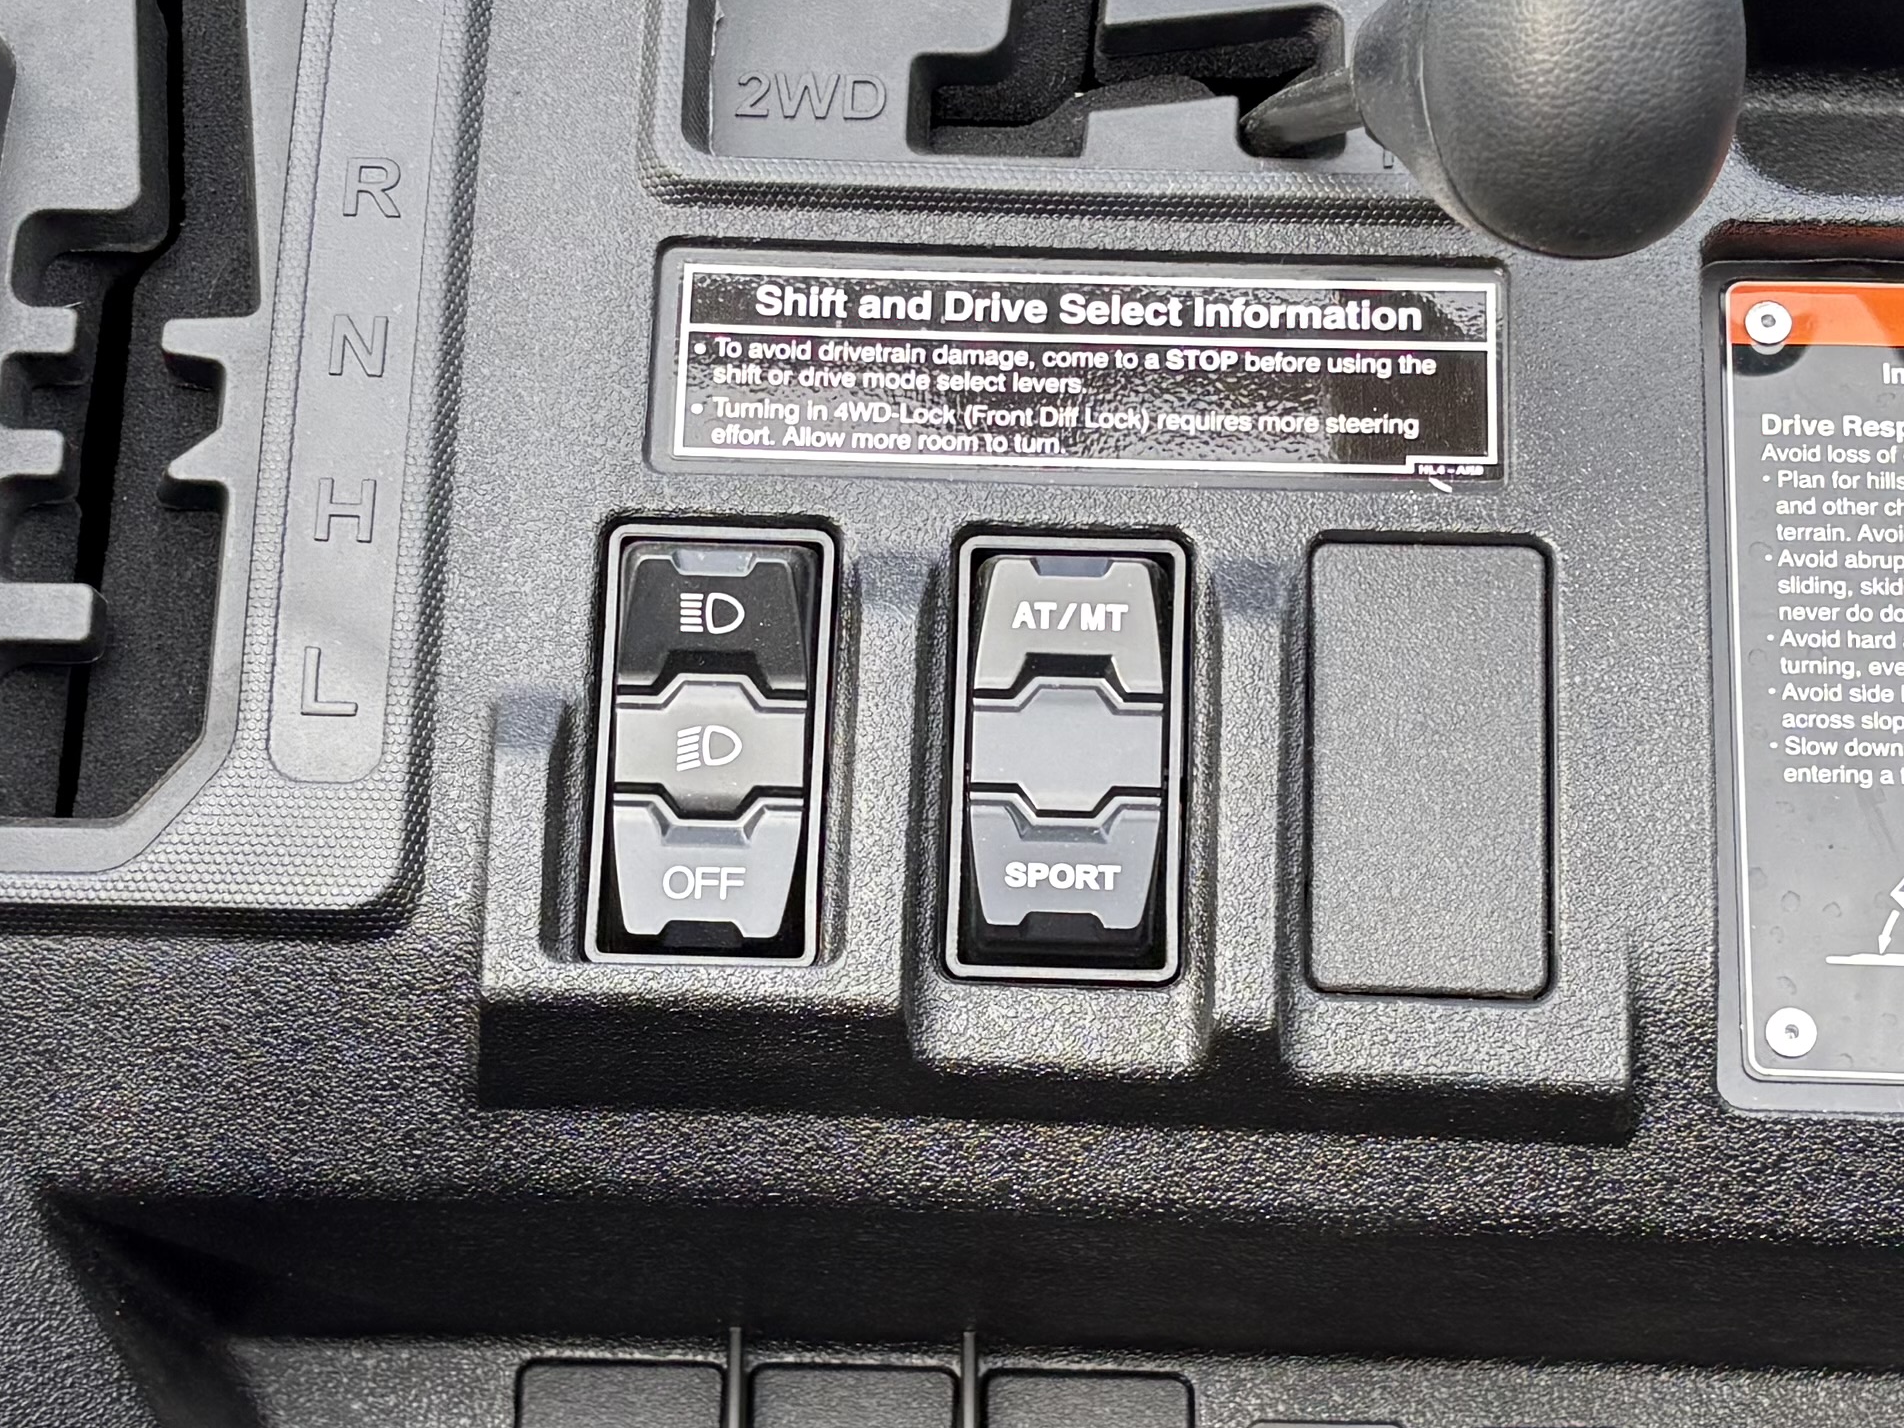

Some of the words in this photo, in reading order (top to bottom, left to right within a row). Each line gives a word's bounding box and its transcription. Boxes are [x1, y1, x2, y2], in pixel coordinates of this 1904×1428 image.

[735, 71, 888, 121] 2WD
[342, 156, 402, 219] R
[755, 284, 848, 318] Shift
[857, 289, 933, 321] and
[944, 289, 1048, 323] Drive
[1059, 292, 1183, 327] Select
[1193, 296, 1423, 332] Information
[328, 313, 389, 378] N
[714, 337, 743, 359] To
[747, 340, 812, 361] avoid
[817, 341, 926, 363] drivetrain
[931, 344, 1036, 370] damage,
[1042, 351, 1109, 369] come
[1114, 349, 1139, 370] to
[1144, 352, 1160, 370] a
[1164, 348, 1238, 372] STOP
[1244, 351, 1321, 373] before
[1326, 353, 1392, 378] using
[1397, 354, 1437, 376] the
[712, 364, 762, 385] shift
[767, 368, 794, 386] or
[798, 366, 856, 388] drive
[862, 370, 931, 390] mode
[936, 372, 1007, 393] select
[1012, 372, 1087, 394] levers.
[711, 396, 800, 426] Turning
[806, 400, 828, 421] in
[833, 401, 957, 425] 4WD-Lock
[963, 404, 1034, 430] (Front
[1039, 406, 1080, 428] Diff
[1084, 408, 1150, 434] Lock)
[1156, 410, 1252, 436] requires
[1257, 415, 1320, 434] more
[1324, 412, 1420, 440] steering
[1761, 413, 1835, 437] Drive
[710, 424, 776, 447] effort.
[782, 426, 846, 449] Allow
[851, 432, 912, 450] more
[917, 433, 979, 452] room
[985, 434, 1009, 454] to
[1013, 433, 1066, 455] turn.
[1761, 443, 1821, 463] Avoid
[1827, 444, 1871, 464] loss
[1876, 444, 1898, 464] of
[1777, 469, 1825, 489] Plan
[1831, 469, 1861, 490] for
[313, 477, 377, 543] H
[1777, 548, 1839, 569] Avoid
[1011, 599, 1130, 633] AT/MT
[300, 645, 359, 717] L
[1784, 735, 1839, 756] Slow
[1843, 737, 1904, 757] down
[1783, 764, 1873, 789] entering
[1879, 769, 1895, 785] a
[661, 865, 747, 901] OFF
[1003, 861, 1122, 892] SPORT
